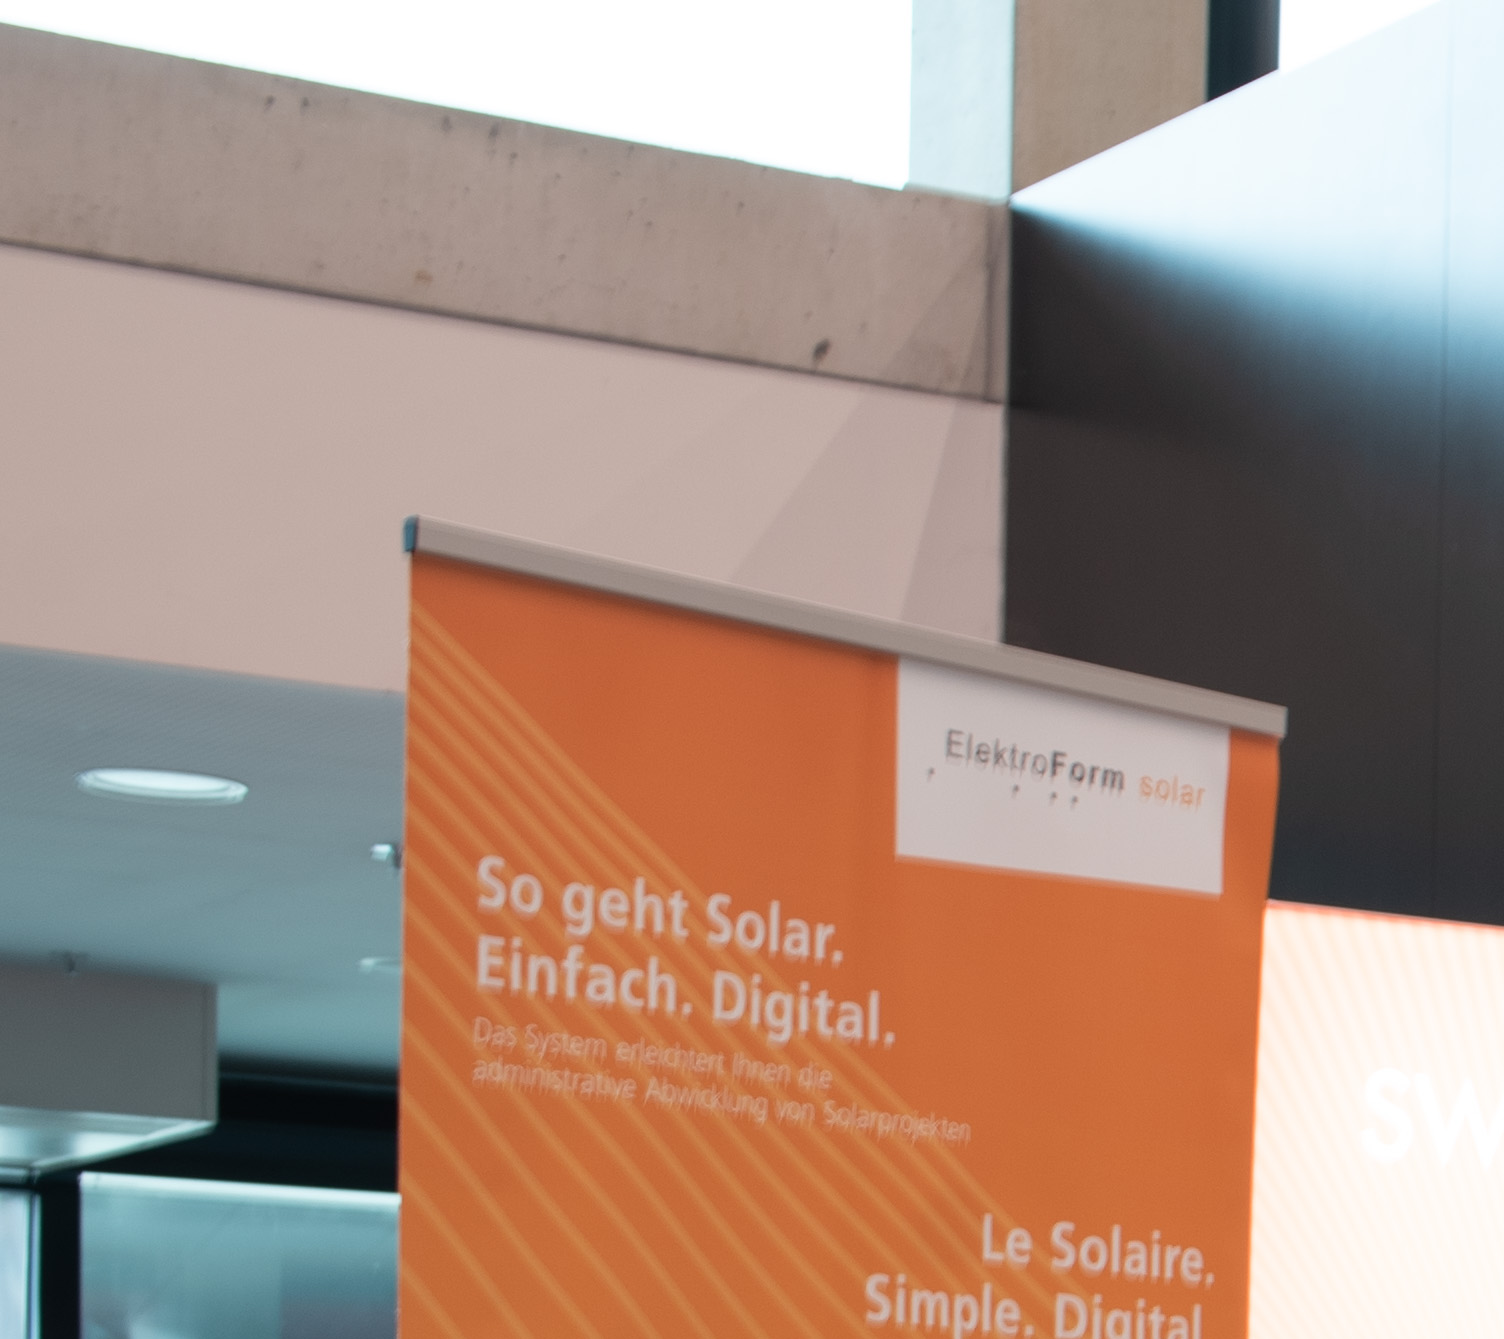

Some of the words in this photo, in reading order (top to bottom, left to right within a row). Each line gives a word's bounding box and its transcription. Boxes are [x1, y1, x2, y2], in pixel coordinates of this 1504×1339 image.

[945, 729, 1124, 791] ElektroForm
[1138, 774, 1205, 807] solar
[477, 855, 543, 914] So
[562, 877, 689, 937] geht
[706, 893, 843, 963] Solar.
[477, 935, 692, 1014] Einfach.
[713, 971, 896, 1046] Digital.
[473, 1016, 517, 1047] Das
[525, 1023, 607, 1060] System
[616, 1038, 724, 1074] erleichtert
[732, 1051, 791, 1083] Ihnen
[799, 1061, 833, 1090] die
[473, 1056, 636, 1098] administrative
[645, 1078, 769, 1121] Abwicklung
[775, 1097, 816, 1122] von
[822, 1101, 971, 1143] Solarprojekten
[982, 1213, 1033, 1264] Le
[1051, 1221, 1214, 1286] Solaire.
